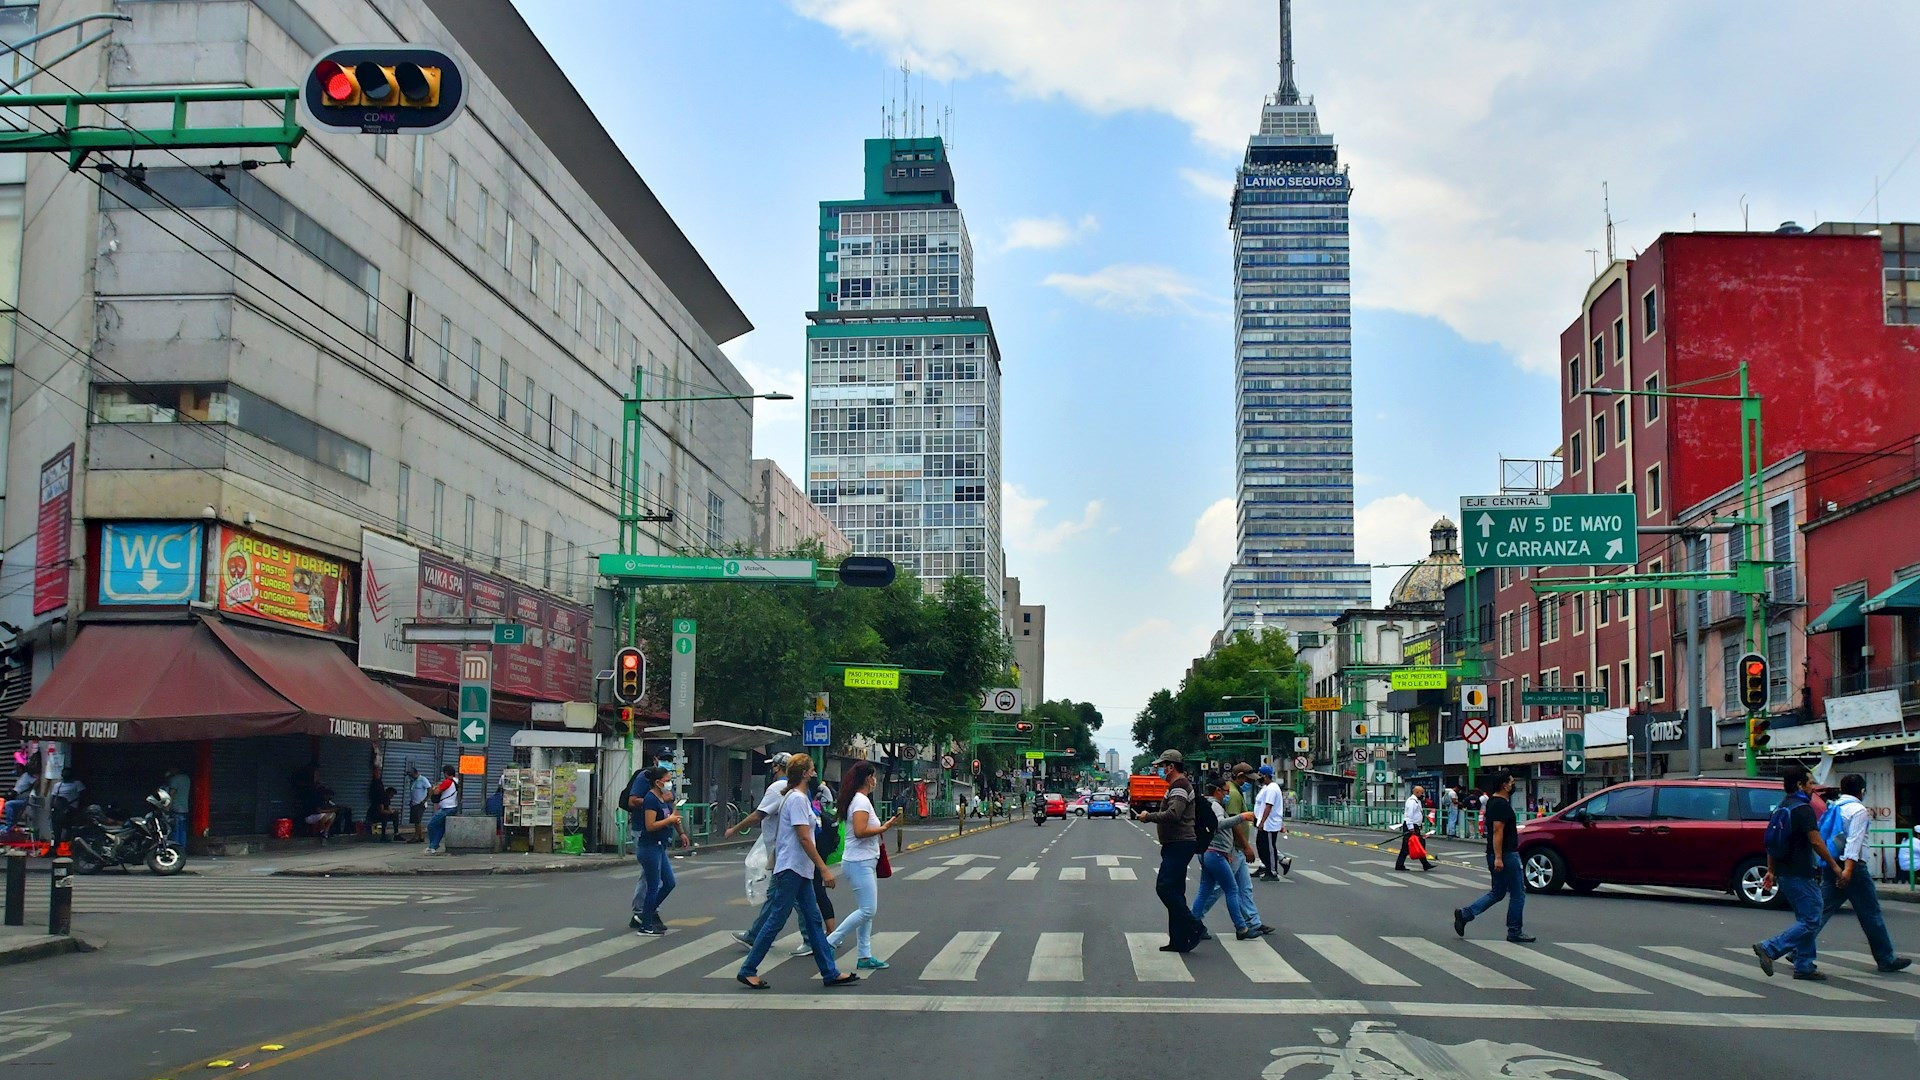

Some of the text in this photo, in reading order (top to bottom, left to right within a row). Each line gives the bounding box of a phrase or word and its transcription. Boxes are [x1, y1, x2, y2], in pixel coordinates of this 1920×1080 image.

[364, 112, 396, 122] CDMX
[1245, 177, 1343, 187] LATINO SEGUROS
[1466, 497, 1543, 506] EJE CENTRAL
[1508, 515, 1623, 533] AV 5 DE MAYO
[120, 534, 182, 570] WC
[235, 534, 340, 579] TACOS Y TORTAS
[1476, 540, 1592, 558] V CARRANZA
[260, 562, 287, 578] PASTOR
[259, 576, 291, 592] SUADERO
[424, 565, 464, 595] YAIKA SPA
[259, 590, 296, 605] LONGANIZA
[258, 603, 308, 622] CAMPECHANOS
[503, 628, 515, 640] 8
[850, 678, 893, 686] TROLEBUS
[863, 671, 896, 679] PREFERENTE
[679, 671, 688, 708] Victoria
[20, 720, 119, 738] TAQUERIA POCHO
[328, 718, 370, 739] TAQUERIA
